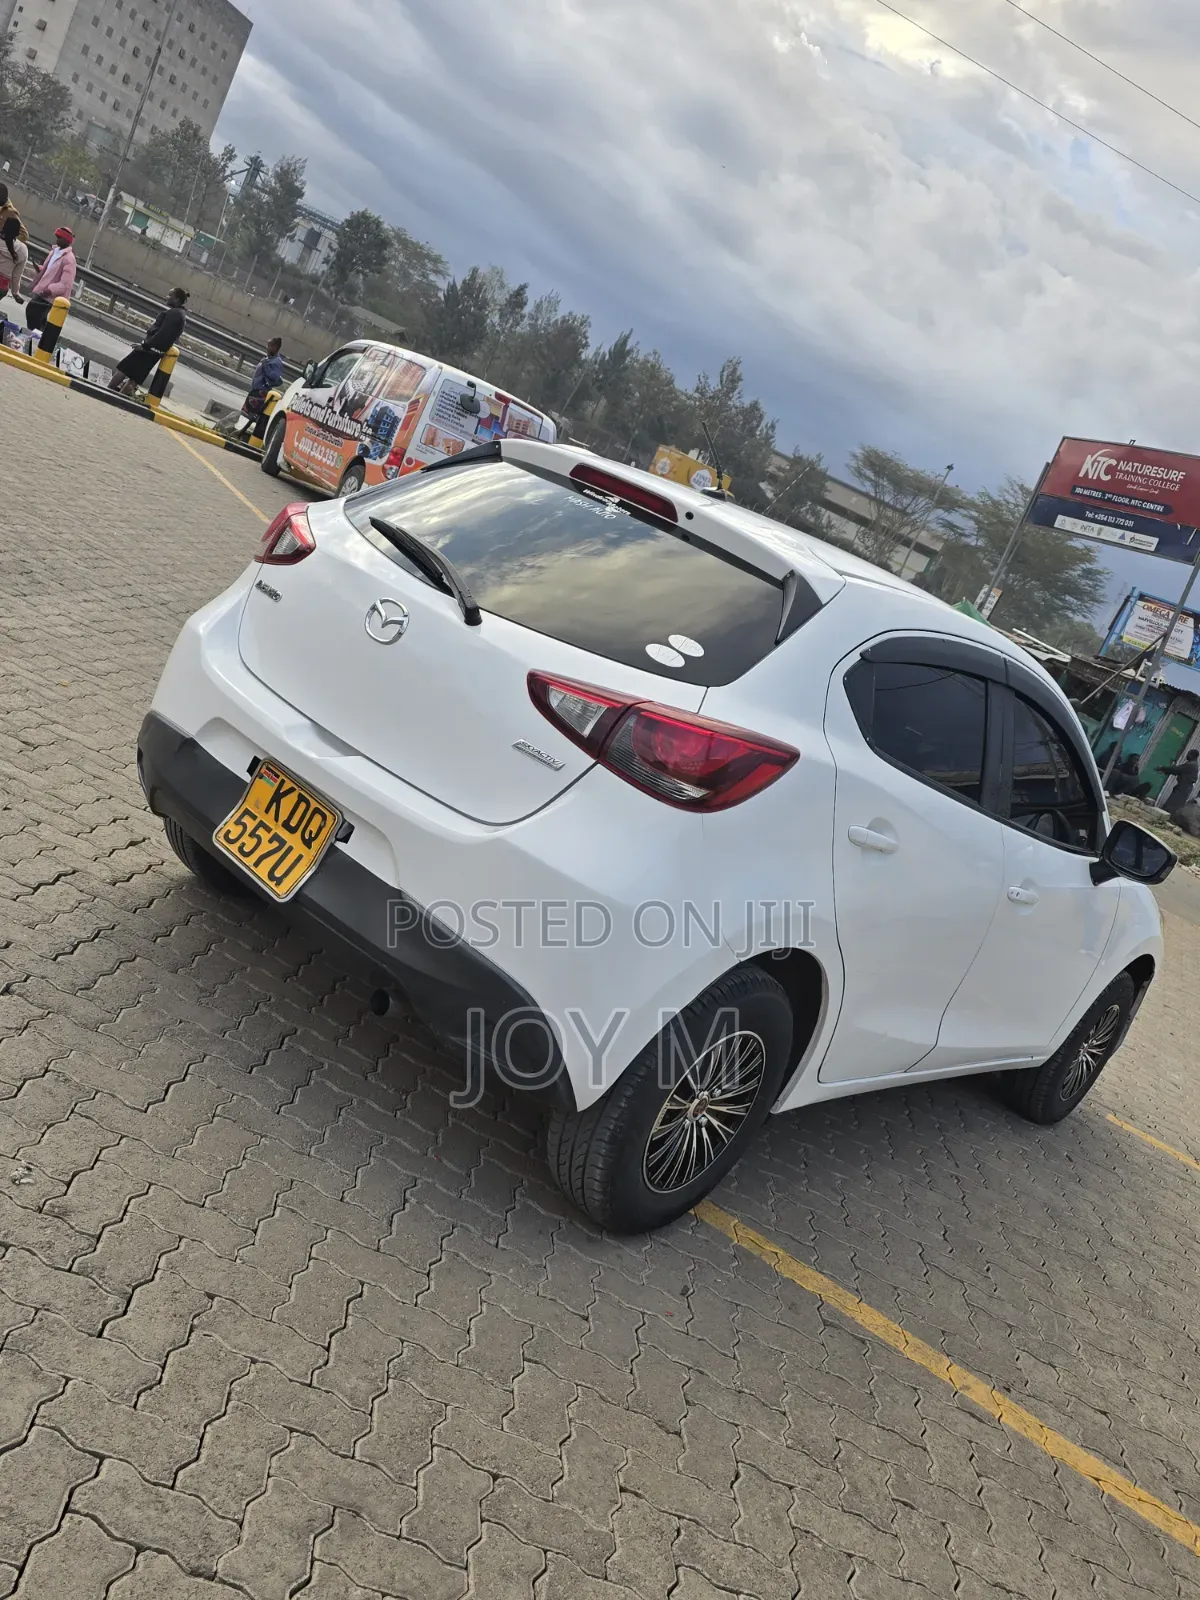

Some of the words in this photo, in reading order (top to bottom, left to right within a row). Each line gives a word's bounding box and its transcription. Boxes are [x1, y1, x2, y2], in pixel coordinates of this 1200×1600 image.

[291, 394, 312, 417] Pallets
[311, 405, 328, 424] and
[323, 408, 361, 438] Furniture
[1079, 449, 1117, 481] NTC
[1118, 460, 1186, 482] NATURESURF
[1115, 472, 1148, 485] TRAINING
[1148, 479, 1180, 491] COLLEGE
[1130, 499, 1142, 507] NTC
[1142, 502, 1164, 512] CENTRE
[1142, 603, 1171, 618] OMEGA
[264, 778, 328, 850] KDQ
[223, 807, 304, 887] 557U
